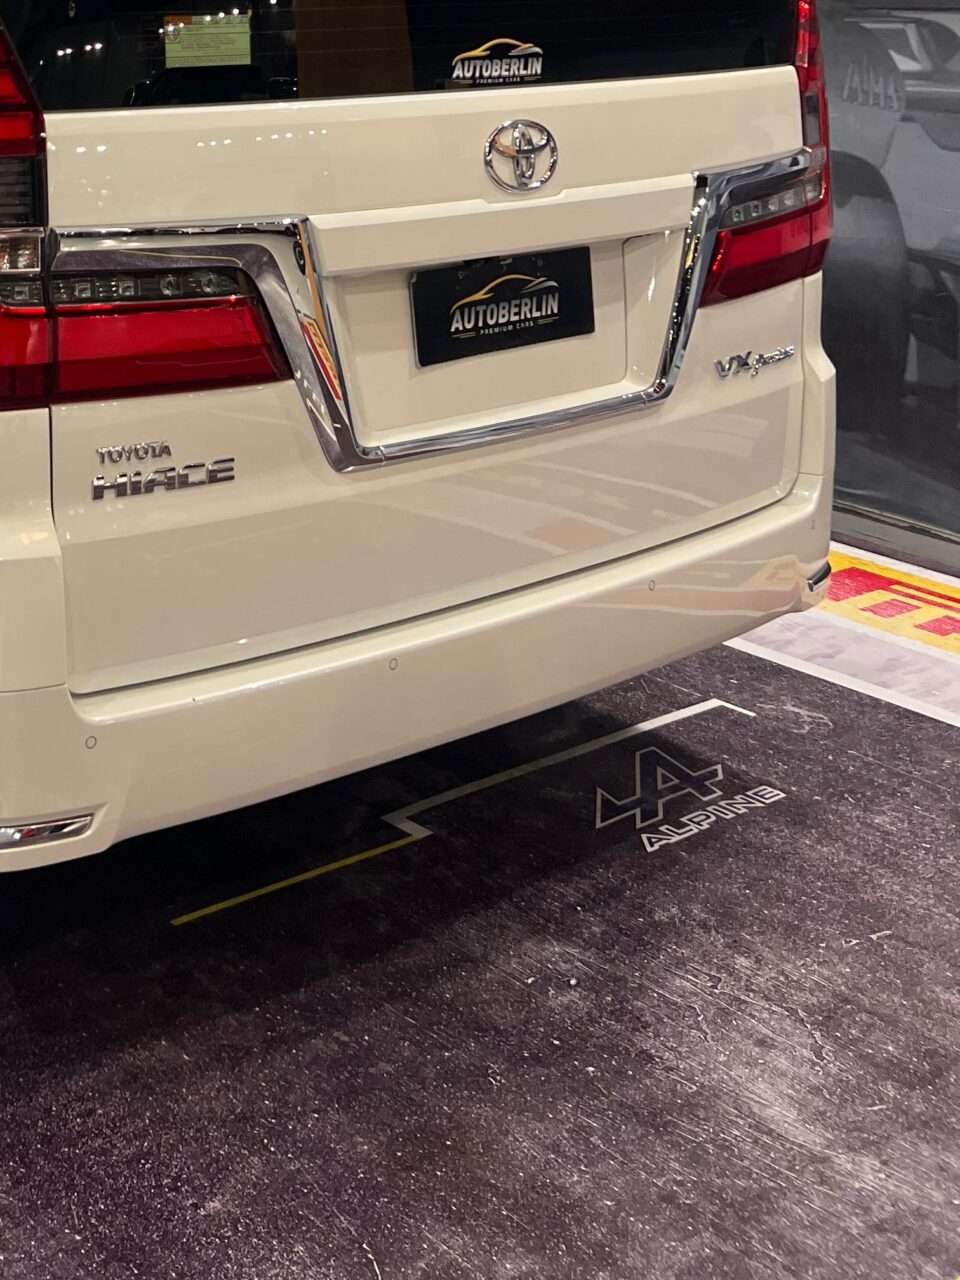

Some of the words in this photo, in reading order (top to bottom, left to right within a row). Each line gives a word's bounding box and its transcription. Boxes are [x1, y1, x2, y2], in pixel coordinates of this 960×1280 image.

[452, 56, 542, 80] AUTOBERLIN
[451, 292, 559, 332] AUTOBERLIN
[712, 350, 752, 378] VX
[96, 440, 172, 464] TOYOTA
[92, 457, 235, 500] HIACE
[641, 785, 787, 852] ALPINE
